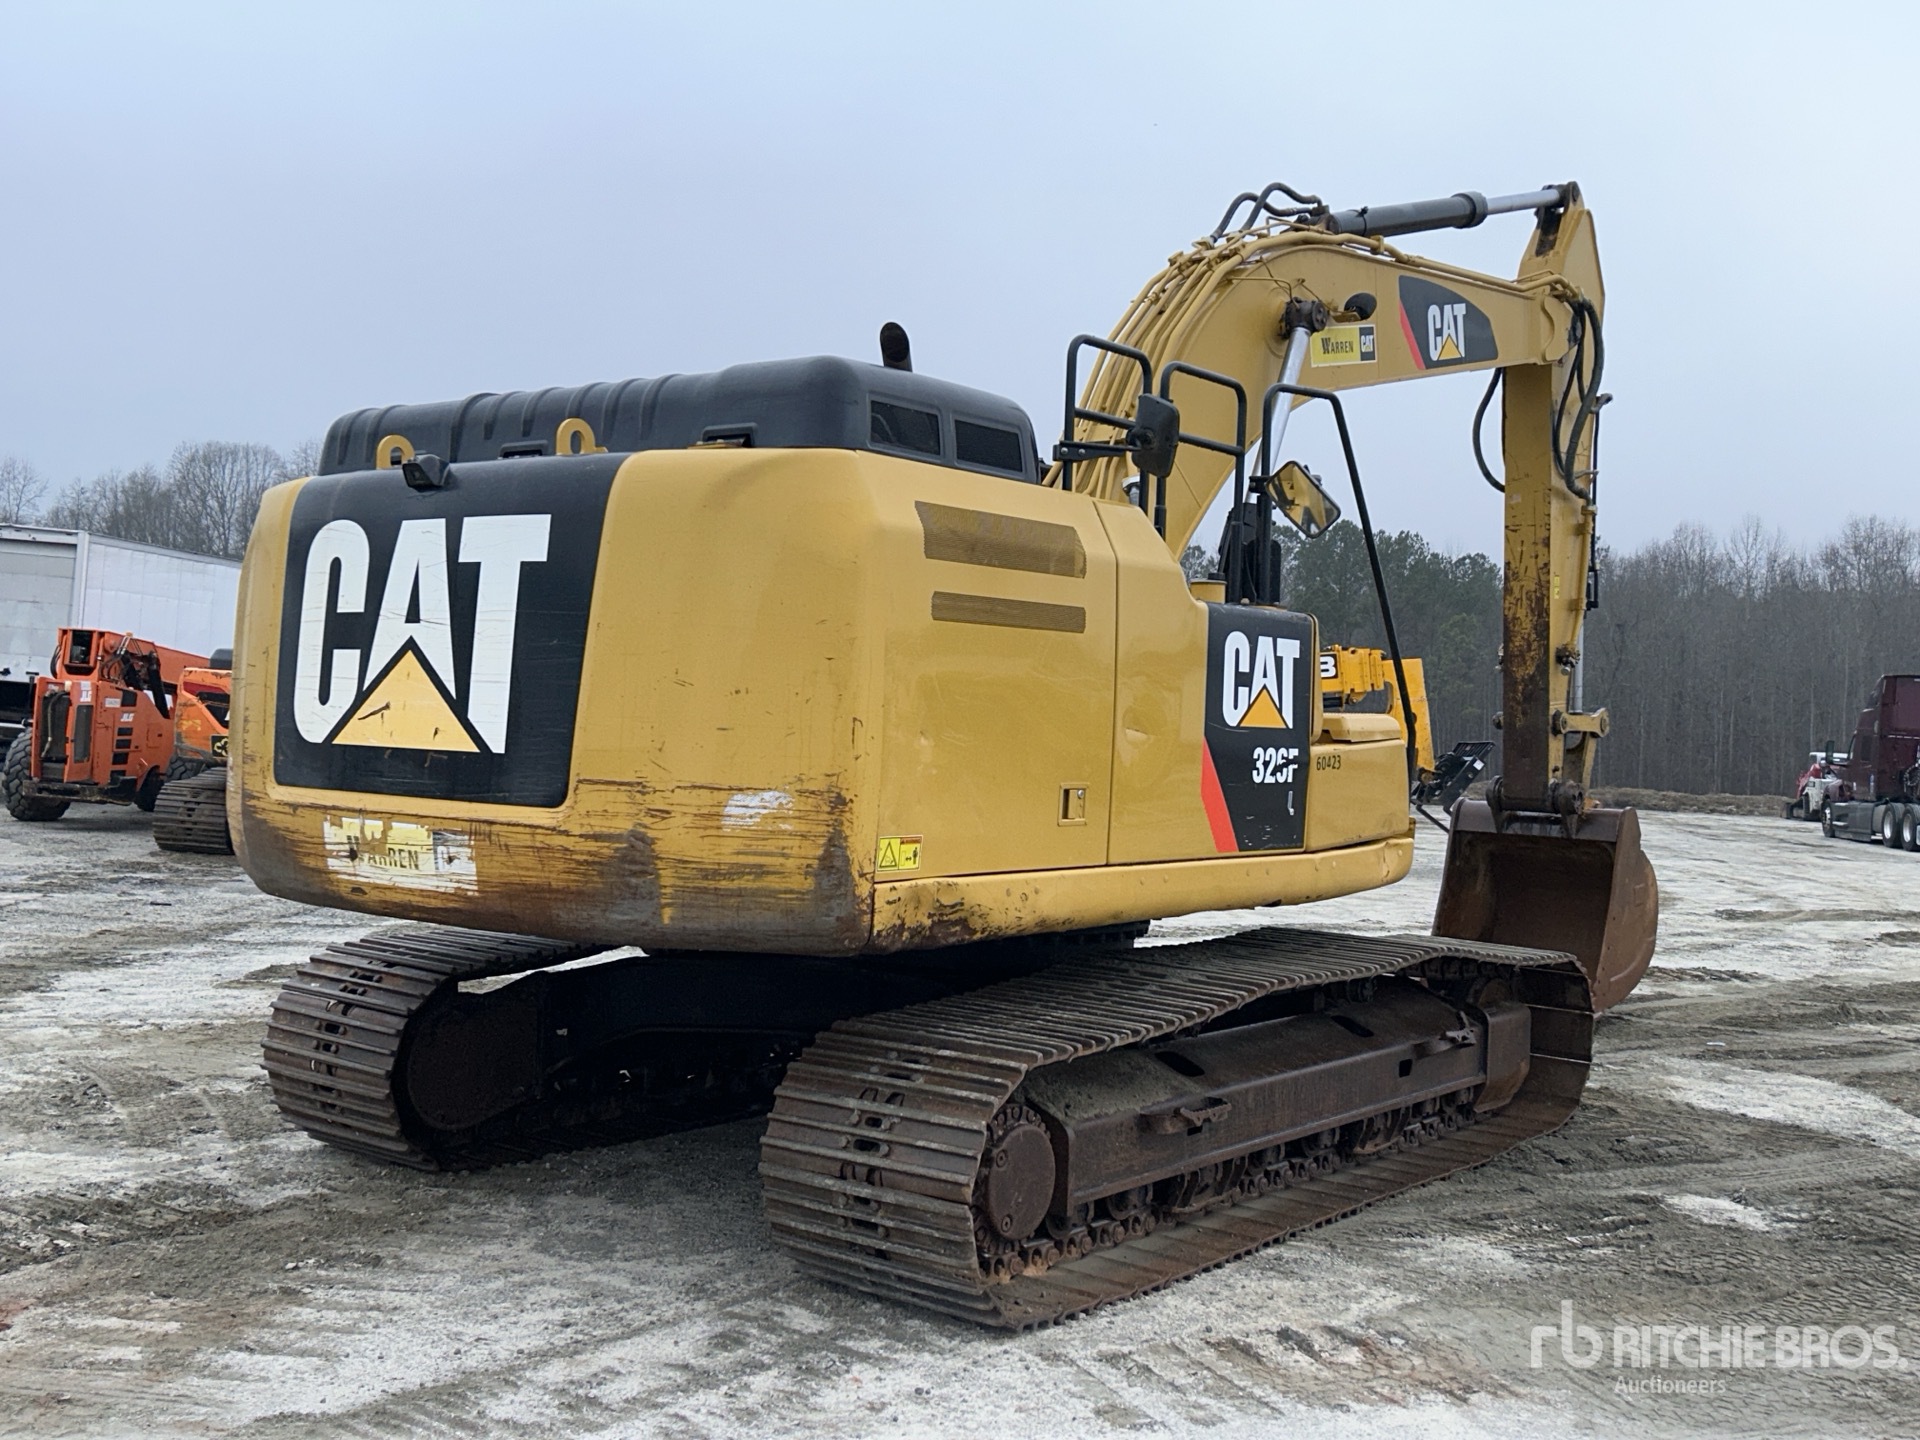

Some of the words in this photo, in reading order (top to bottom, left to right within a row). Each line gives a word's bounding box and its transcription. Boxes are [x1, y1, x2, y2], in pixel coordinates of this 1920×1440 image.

[1321, 336, 1354, 355] WARREN
[1361, 334, 1374, 353] CAT
[1427, 303, 1467, 361] CAT
[293, 513, 552, 754] CAT
[1222, 631, 1300, 729] CAT
[1316, 755, 1341, 771] 60423
